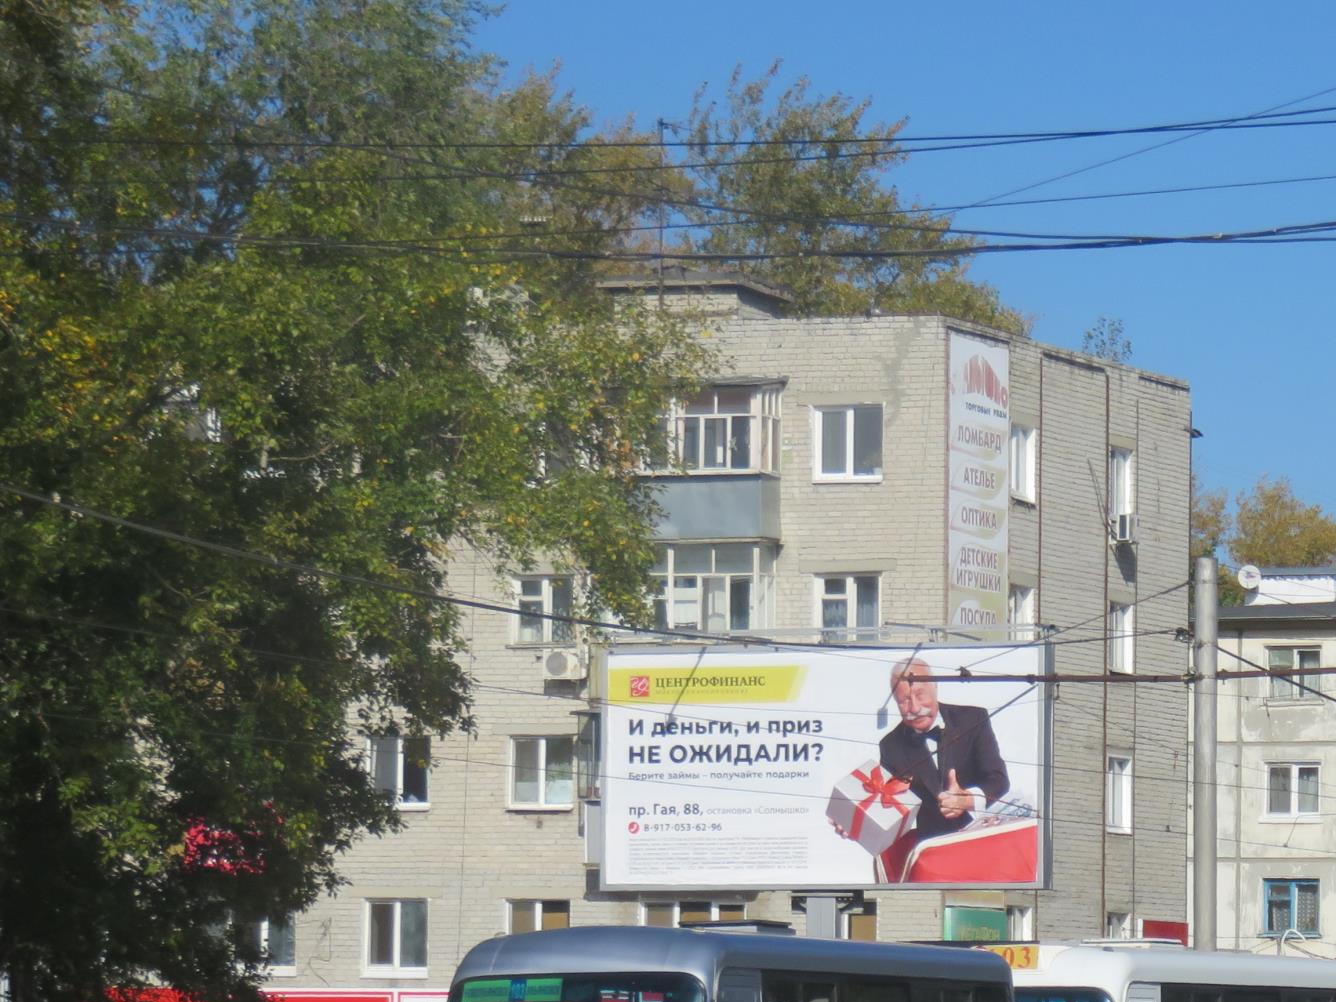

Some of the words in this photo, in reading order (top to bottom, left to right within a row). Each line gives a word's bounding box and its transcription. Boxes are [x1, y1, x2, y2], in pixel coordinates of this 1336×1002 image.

[958, 425, 1001, 453] ЛОМБАРД
[963, 467, 995, 489] АТЕЛЬЕ
[961, 506, 997, 529] ОПТИКА
[960, 547, 998, 570] ДЕТСКИЕ
[957, 567, 1000, 591] ИГРУШКИ
[655, 676, 766, 688] ЦЕНТРОФИНАНС
[629, 719, 643, 735] И
[651, 719, 739, 737] деньги,
[747, 721, 760, 734] и
[768, 720, 823, 738] приз
[629, 745, 660, 763] НЕ
[669, 743, 824, 766] ОЖИДАЛИ?
[628, 772, 664, 780] Берите
[668, 771, 699, 779] займы
[710, 771, 763, 780] получайте
[767, 771, 809, 780] подарки
[629, 806, 649, 818] пр.
[653, 804, 679, 816] Гая,
[683, 804, 703, 816] 88,
